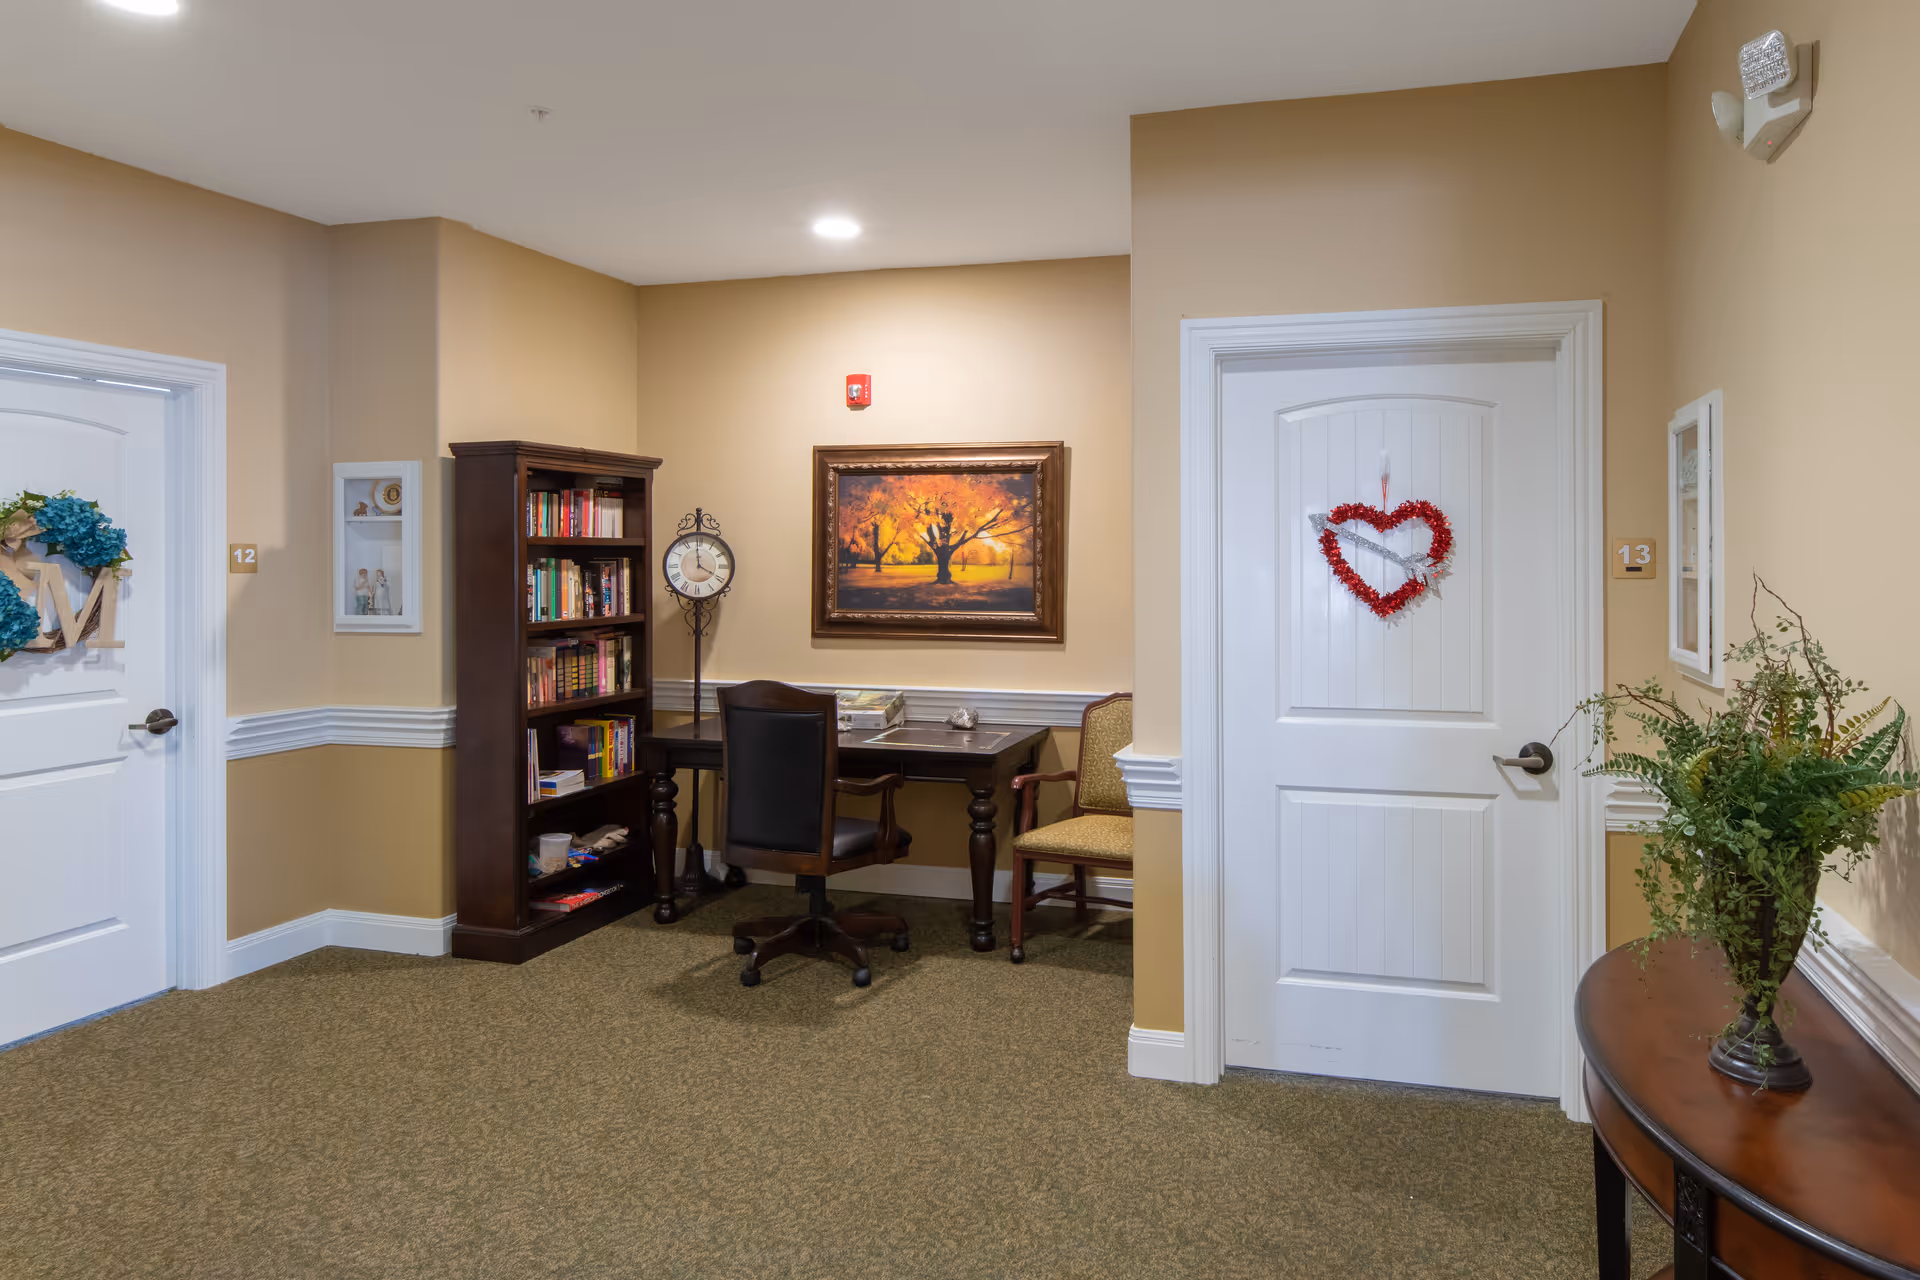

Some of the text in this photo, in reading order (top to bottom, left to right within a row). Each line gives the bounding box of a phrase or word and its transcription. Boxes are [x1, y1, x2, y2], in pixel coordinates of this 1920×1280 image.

[233, 548, 256, 563] 12
[1618, 544, 1651, 564] 13
[25, 562, 133, 649] M
